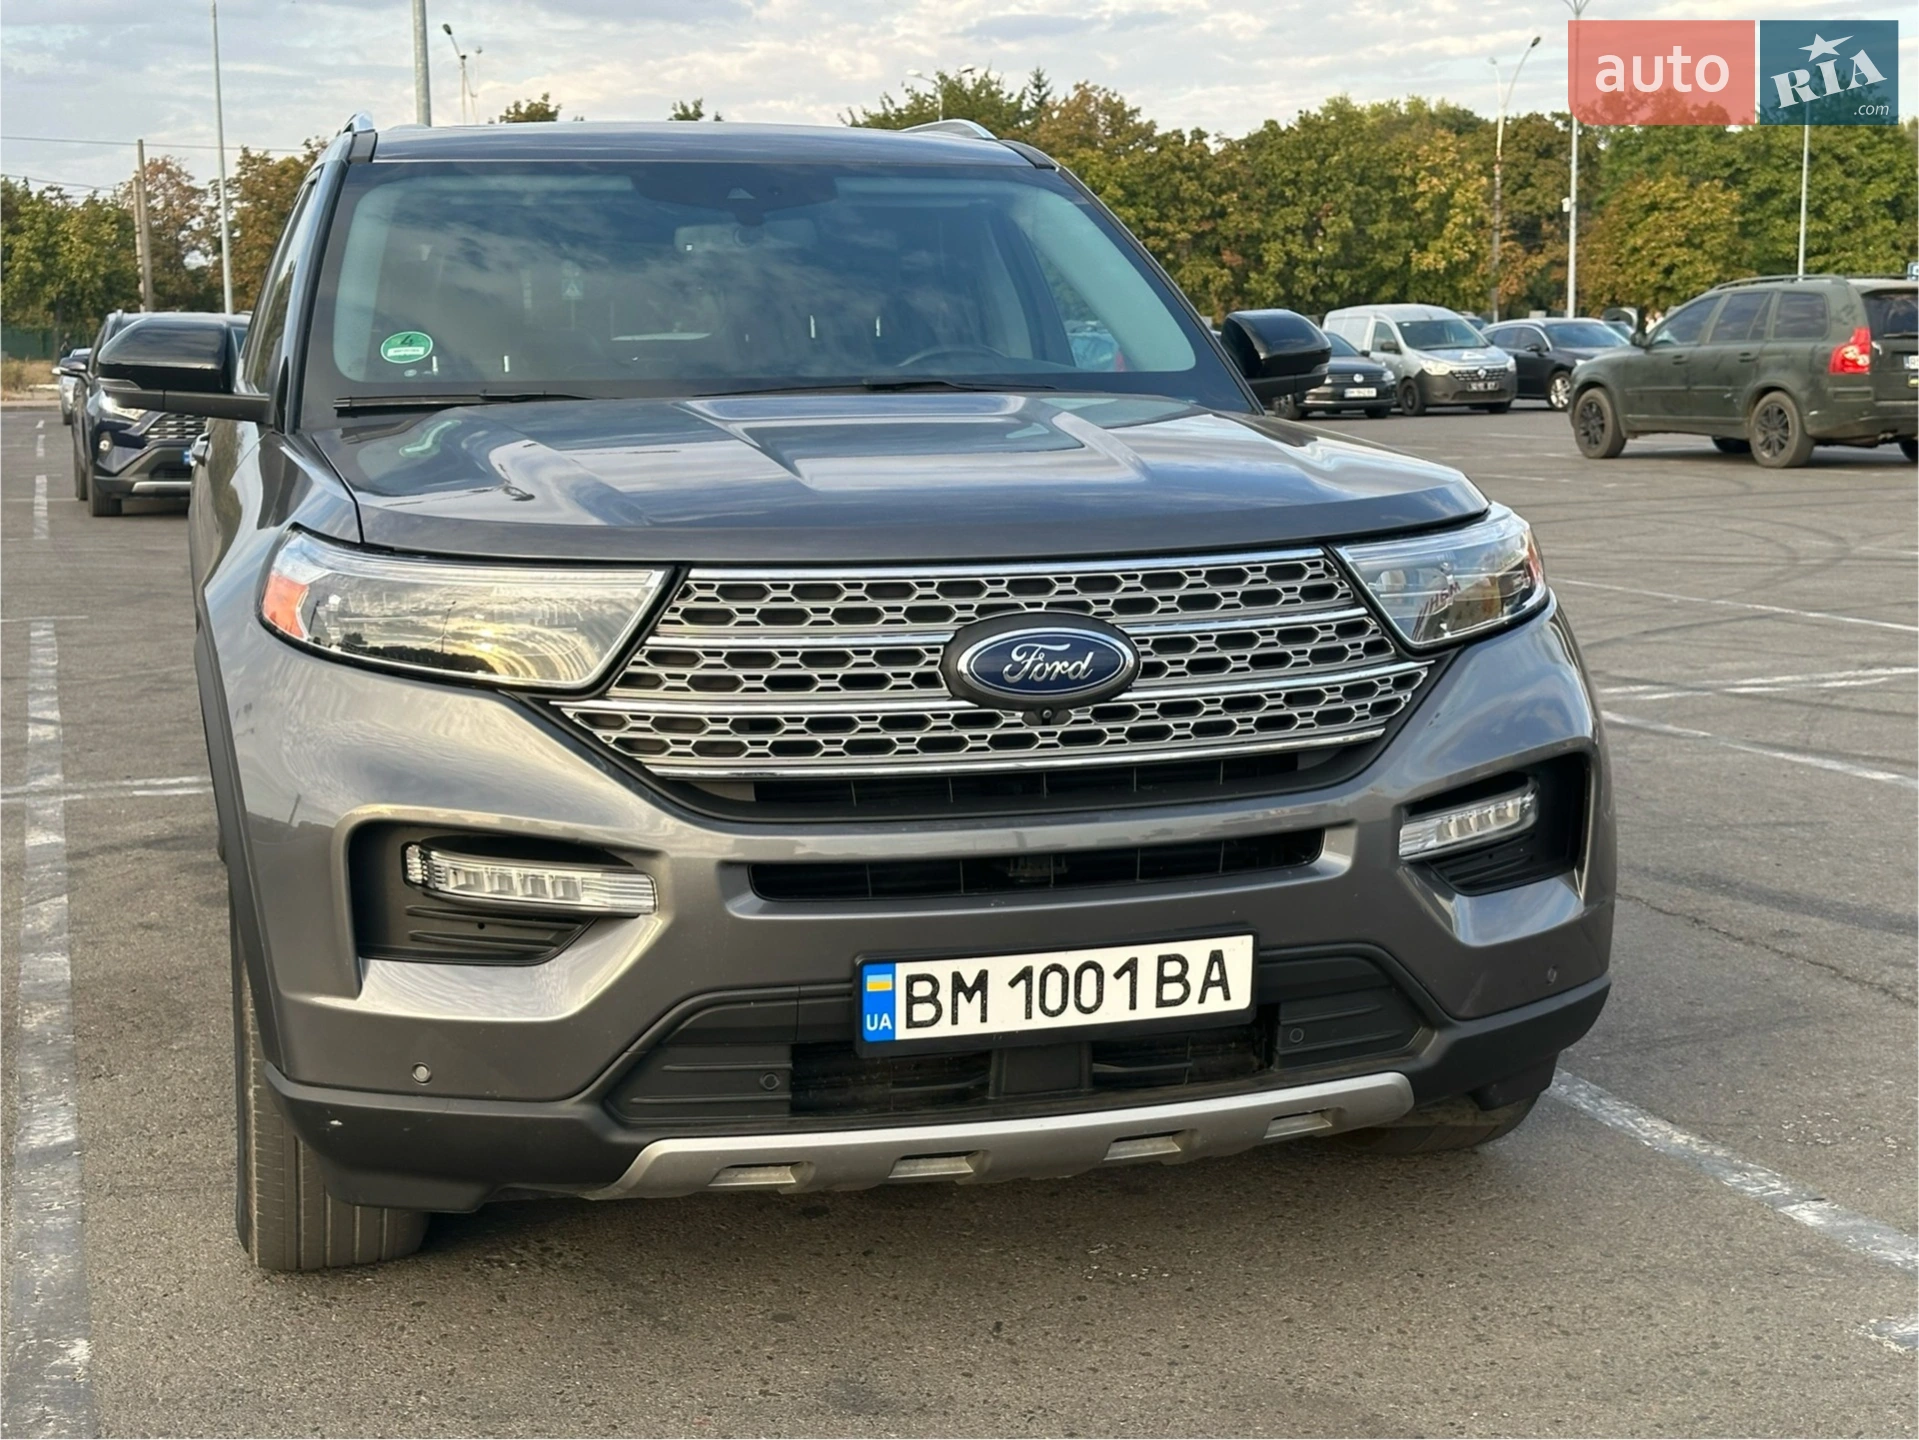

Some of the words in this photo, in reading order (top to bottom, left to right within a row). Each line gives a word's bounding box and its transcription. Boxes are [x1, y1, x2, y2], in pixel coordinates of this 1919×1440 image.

[1002, 643, 1094, 684] Ford
[905, 968, 989, 1029] BM
[1008, 956, 1138, 1020] 1001
[1155, 949, 1232, 1009] BA
[866, 1012, 893, 1032] UA
